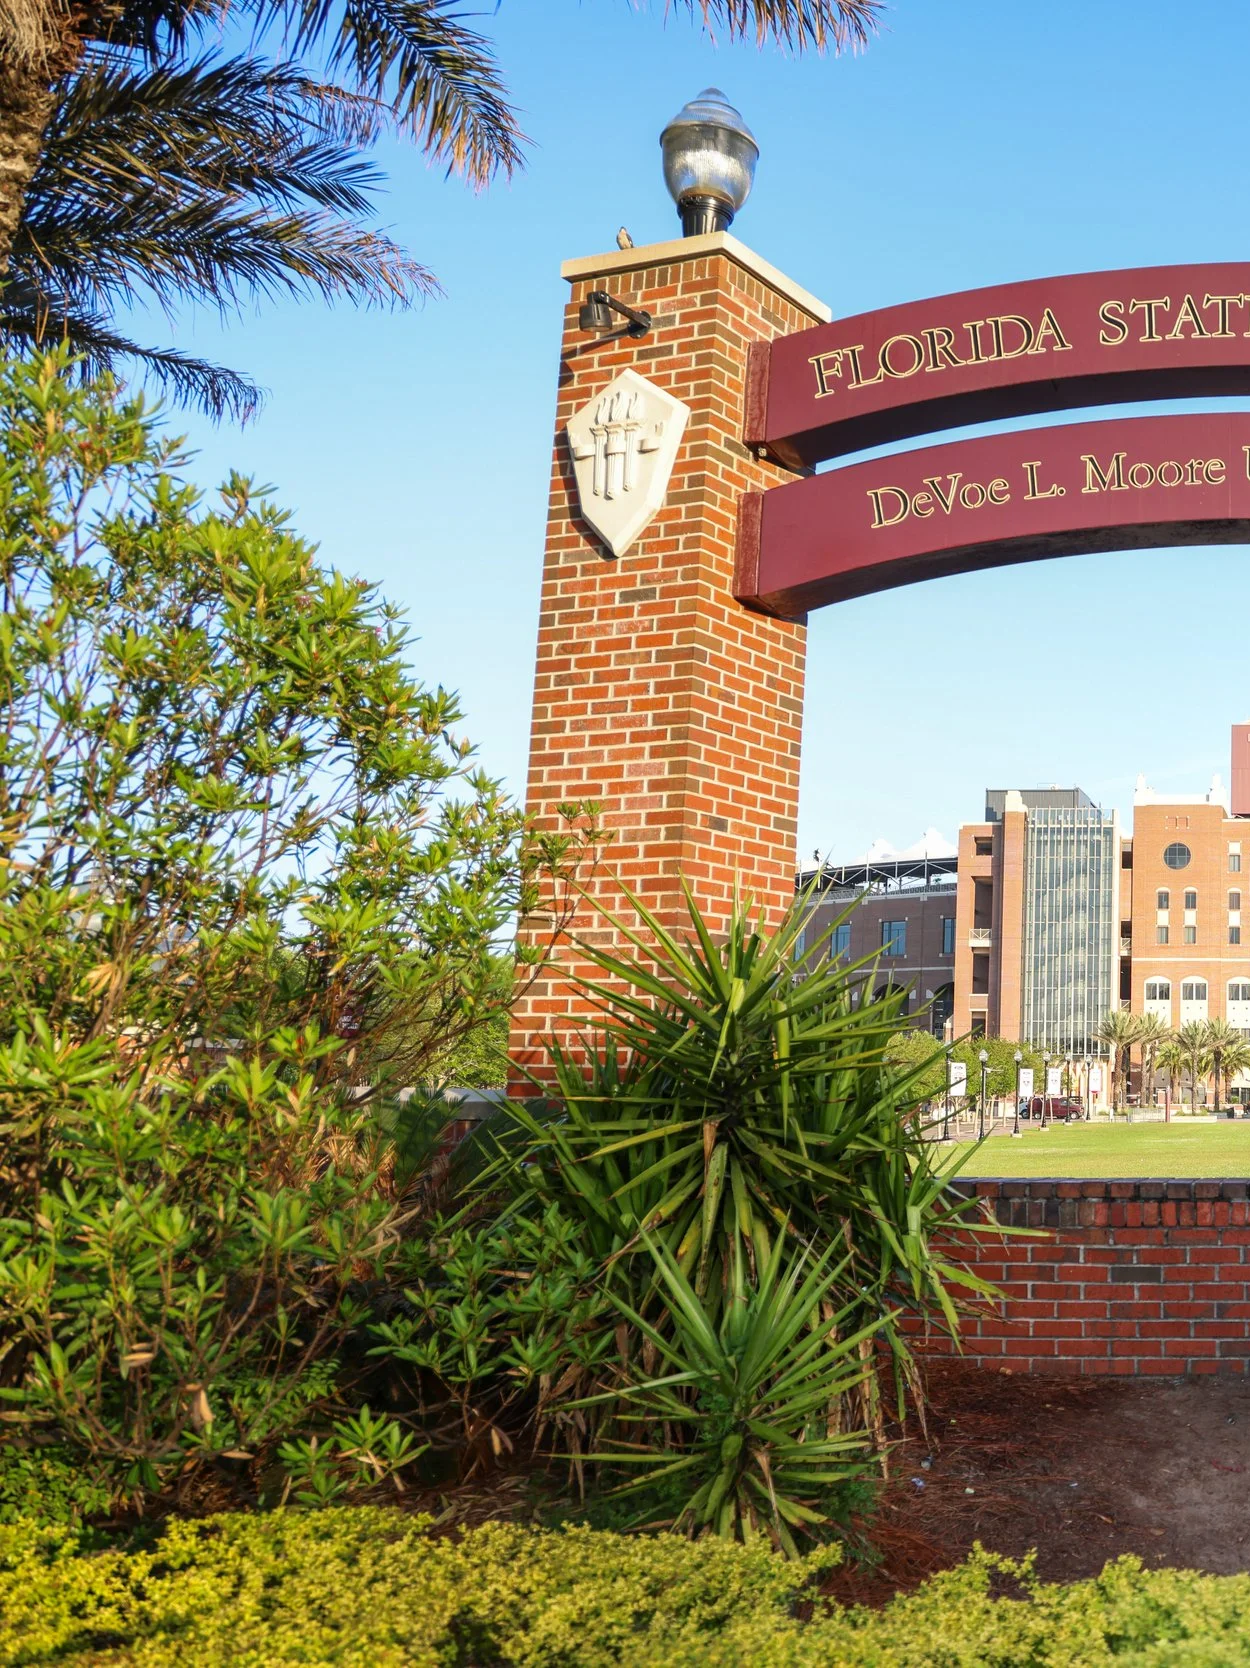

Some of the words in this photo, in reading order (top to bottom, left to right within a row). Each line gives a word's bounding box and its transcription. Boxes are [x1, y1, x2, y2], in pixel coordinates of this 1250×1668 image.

[808, 308, 1073, 399] FLORIDA
[867, 472, 1011, 529] DeVoe
[1022, 461, 1066, 500] L.
[1081, 452, 1226, 494] Moore
